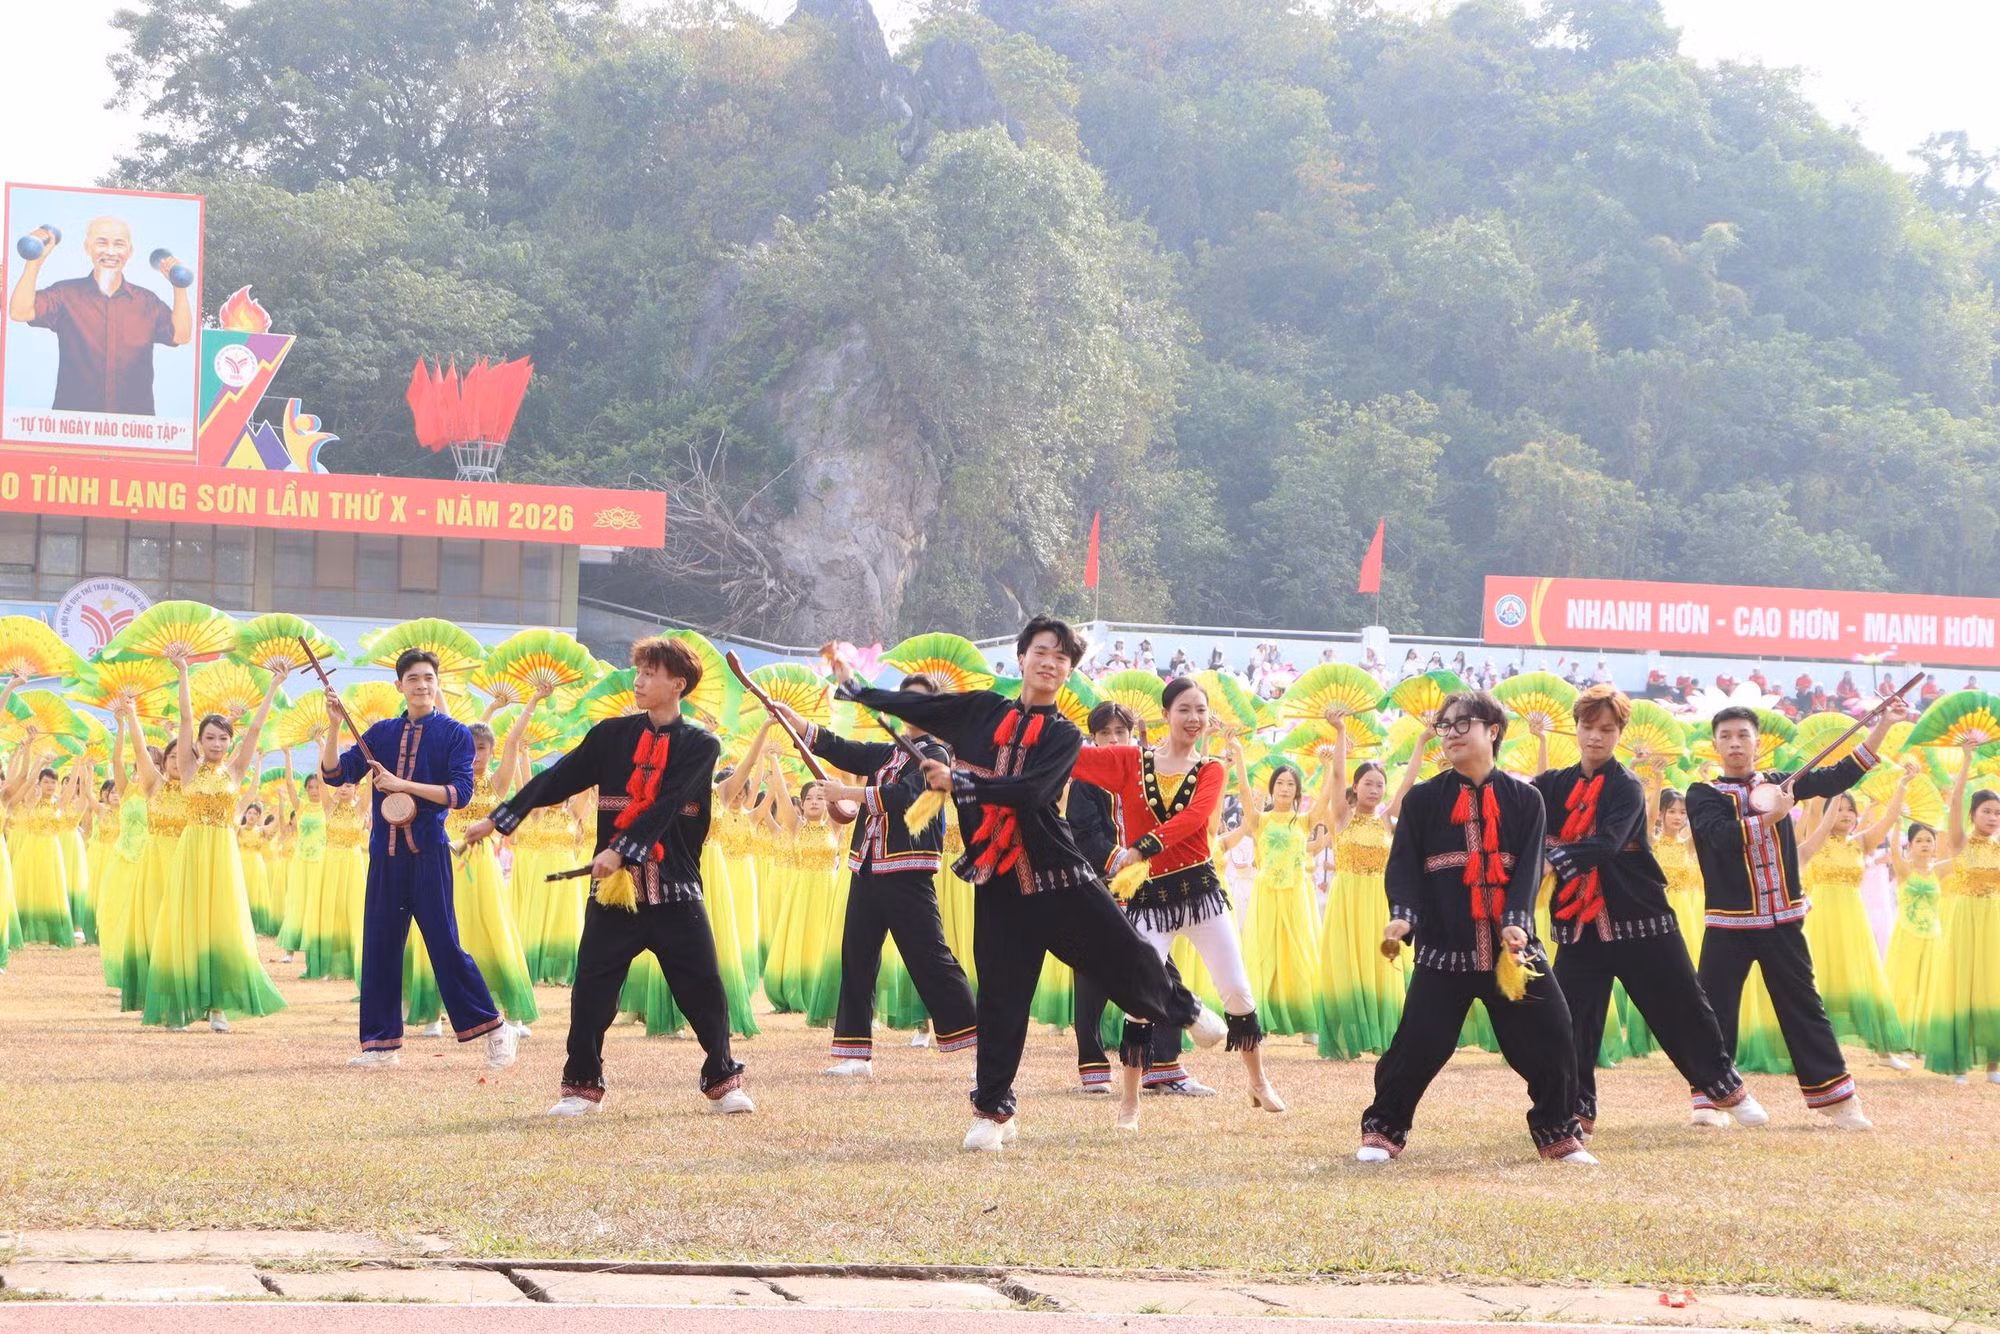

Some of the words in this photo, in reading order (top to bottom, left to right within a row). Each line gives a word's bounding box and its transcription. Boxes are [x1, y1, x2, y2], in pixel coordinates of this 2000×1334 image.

[38, 415, 56, 433] TÔI
[60, 417, 91, 435] NGÀY
[94, 418, 118, 437] NÀO
[122, 420, 154, 439] CŨNG
[30, 465, 99, 506] TỈNH
[109, 479, 187, 514] LẠNG
[196, 482, 257, 515] SƠN
[266, 480, 320, 518] LẦN
[328, 488, 384, 523] THỨ
[389, 494, 408, 523] X
[436, 493, 499, 528] NĂM
[508, 501, 575, 532] 2026
[1567, 598, 1651, 632] NHANH
[1659, 600, 1709, 634] HƠN
[1733, 606, 1782, 638] CAO
[1788, 607, 1840, 641] HƠN
[1863, 612, 1938, 650] MẠNH
[1943, 614, 1995, 648] HƠN
